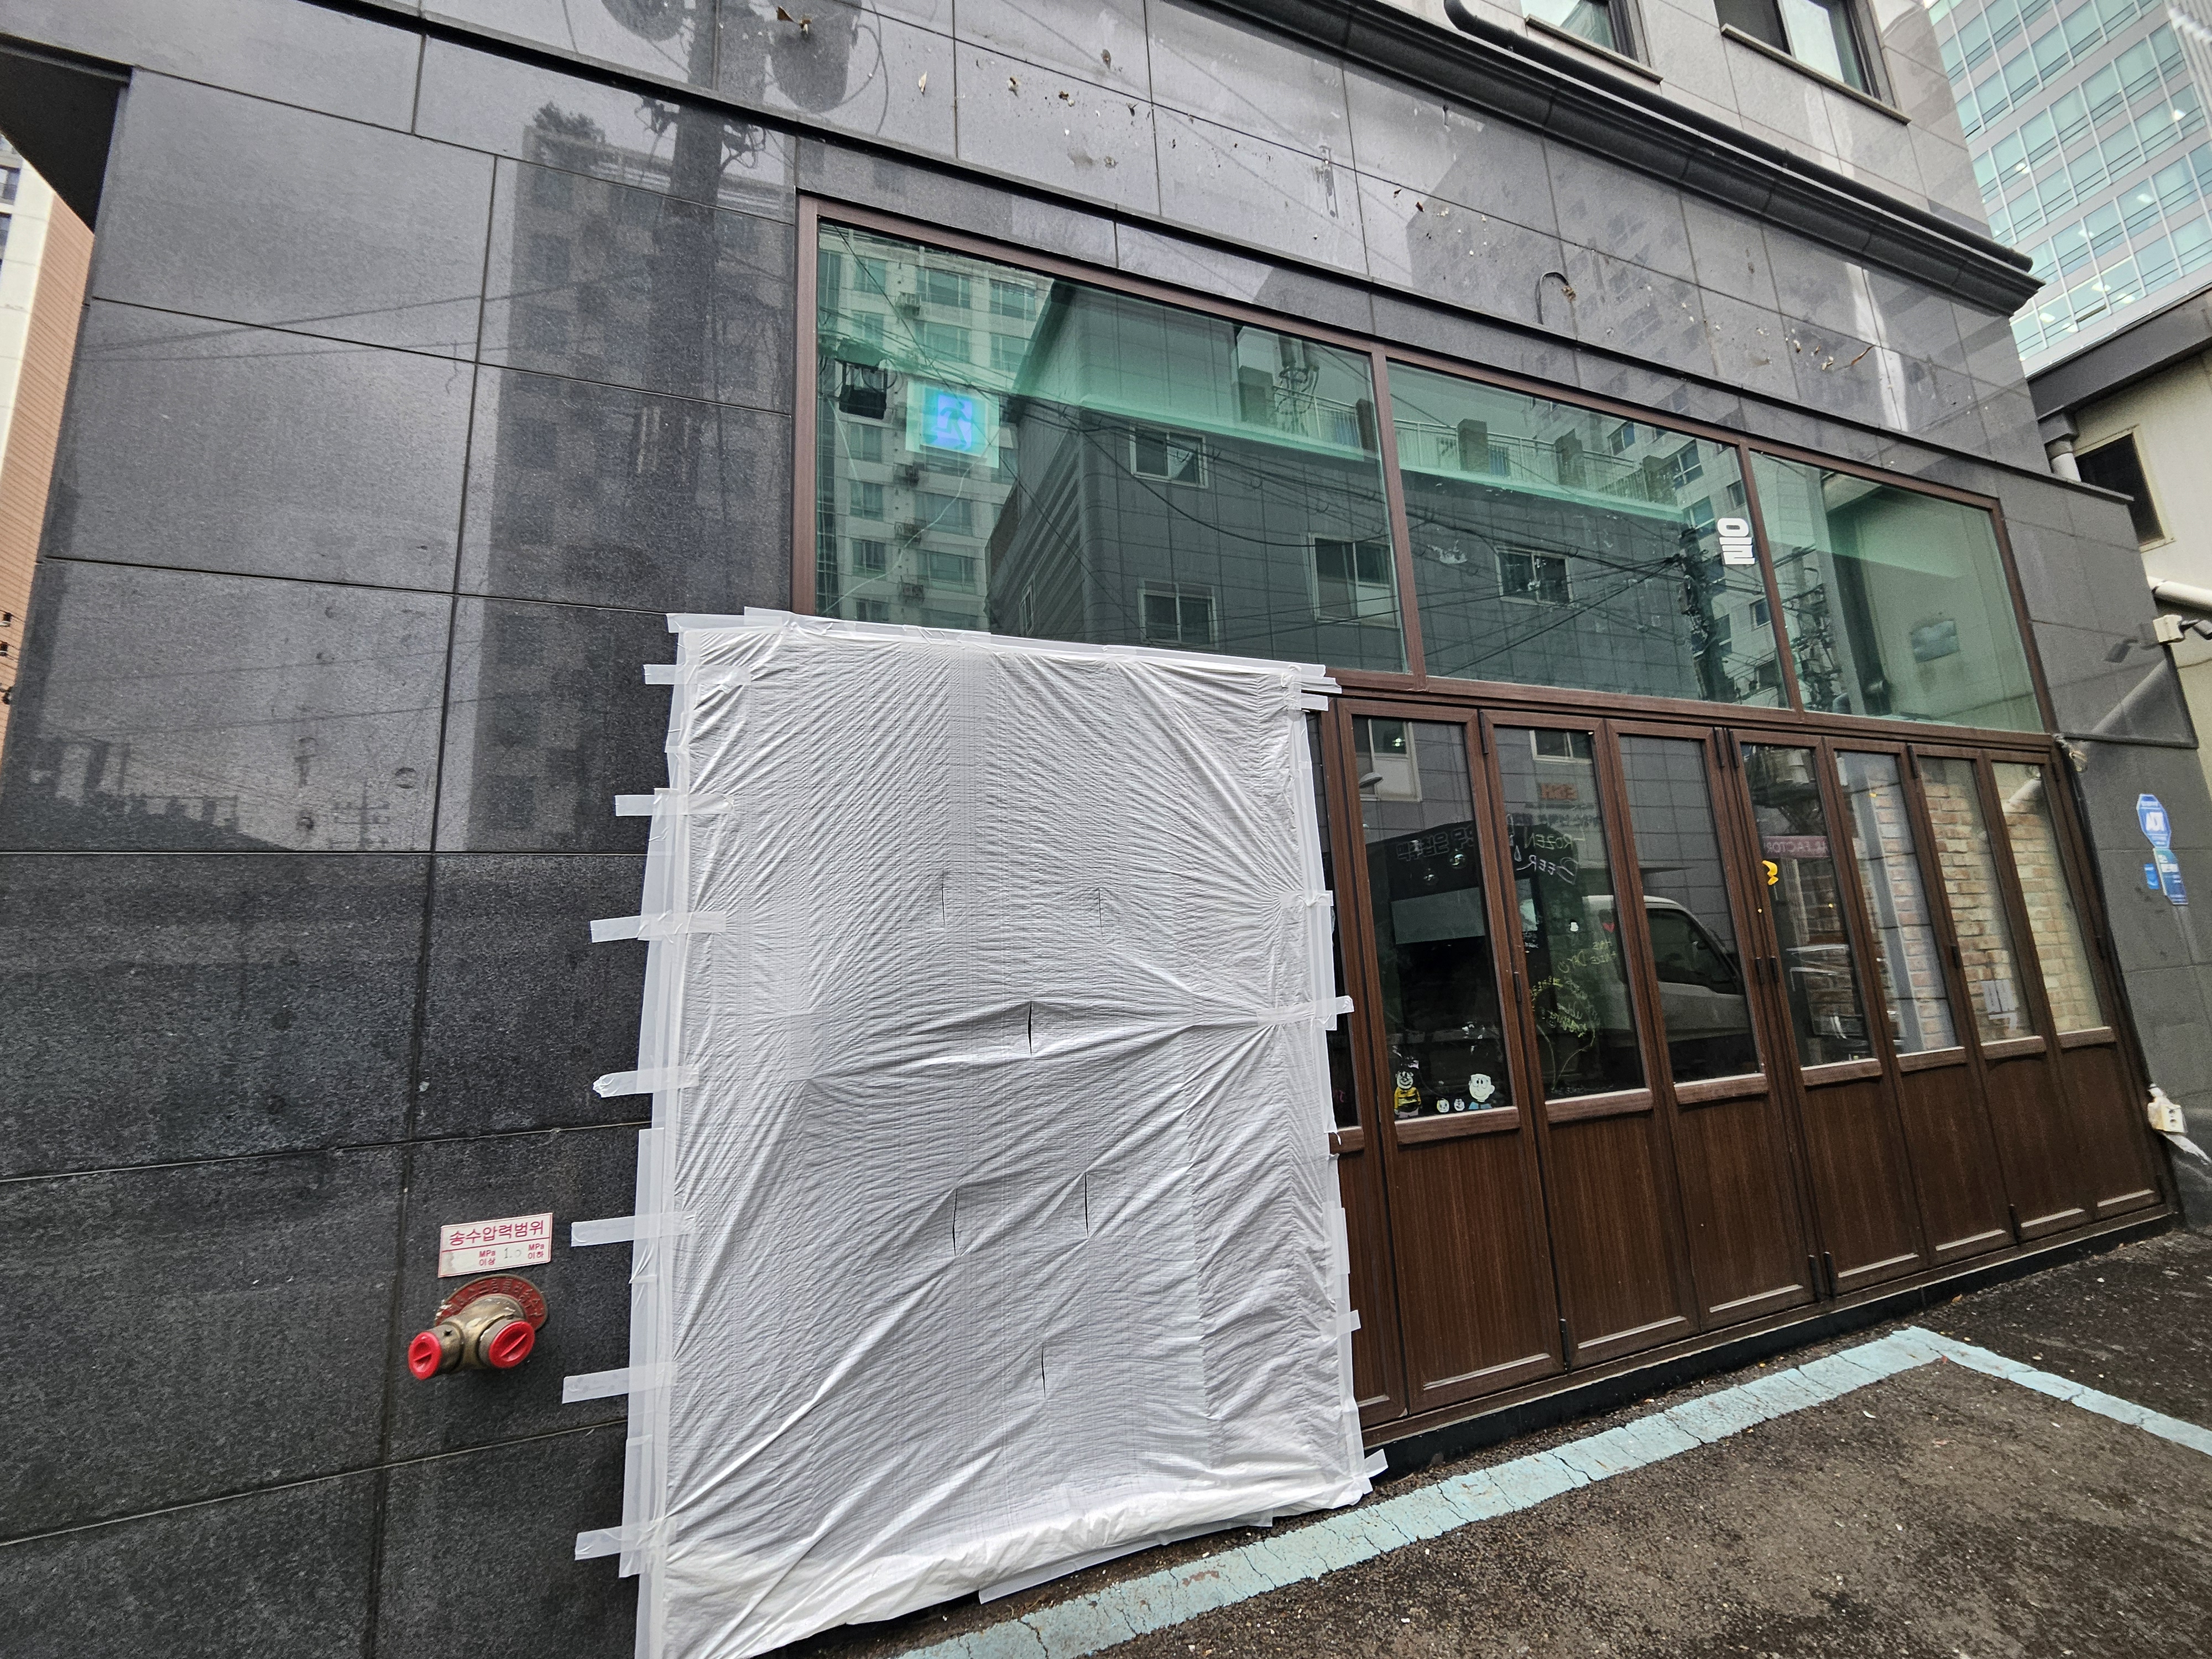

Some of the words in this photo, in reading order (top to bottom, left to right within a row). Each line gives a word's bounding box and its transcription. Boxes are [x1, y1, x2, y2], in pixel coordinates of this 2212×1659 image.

[1717, 518, 1755, 565] 을
[450, 1220, 544, 1246] 송수압력범위
[479, 1258, 495, 1266] 이상
[528, 1251, 544, 1260] 이하
